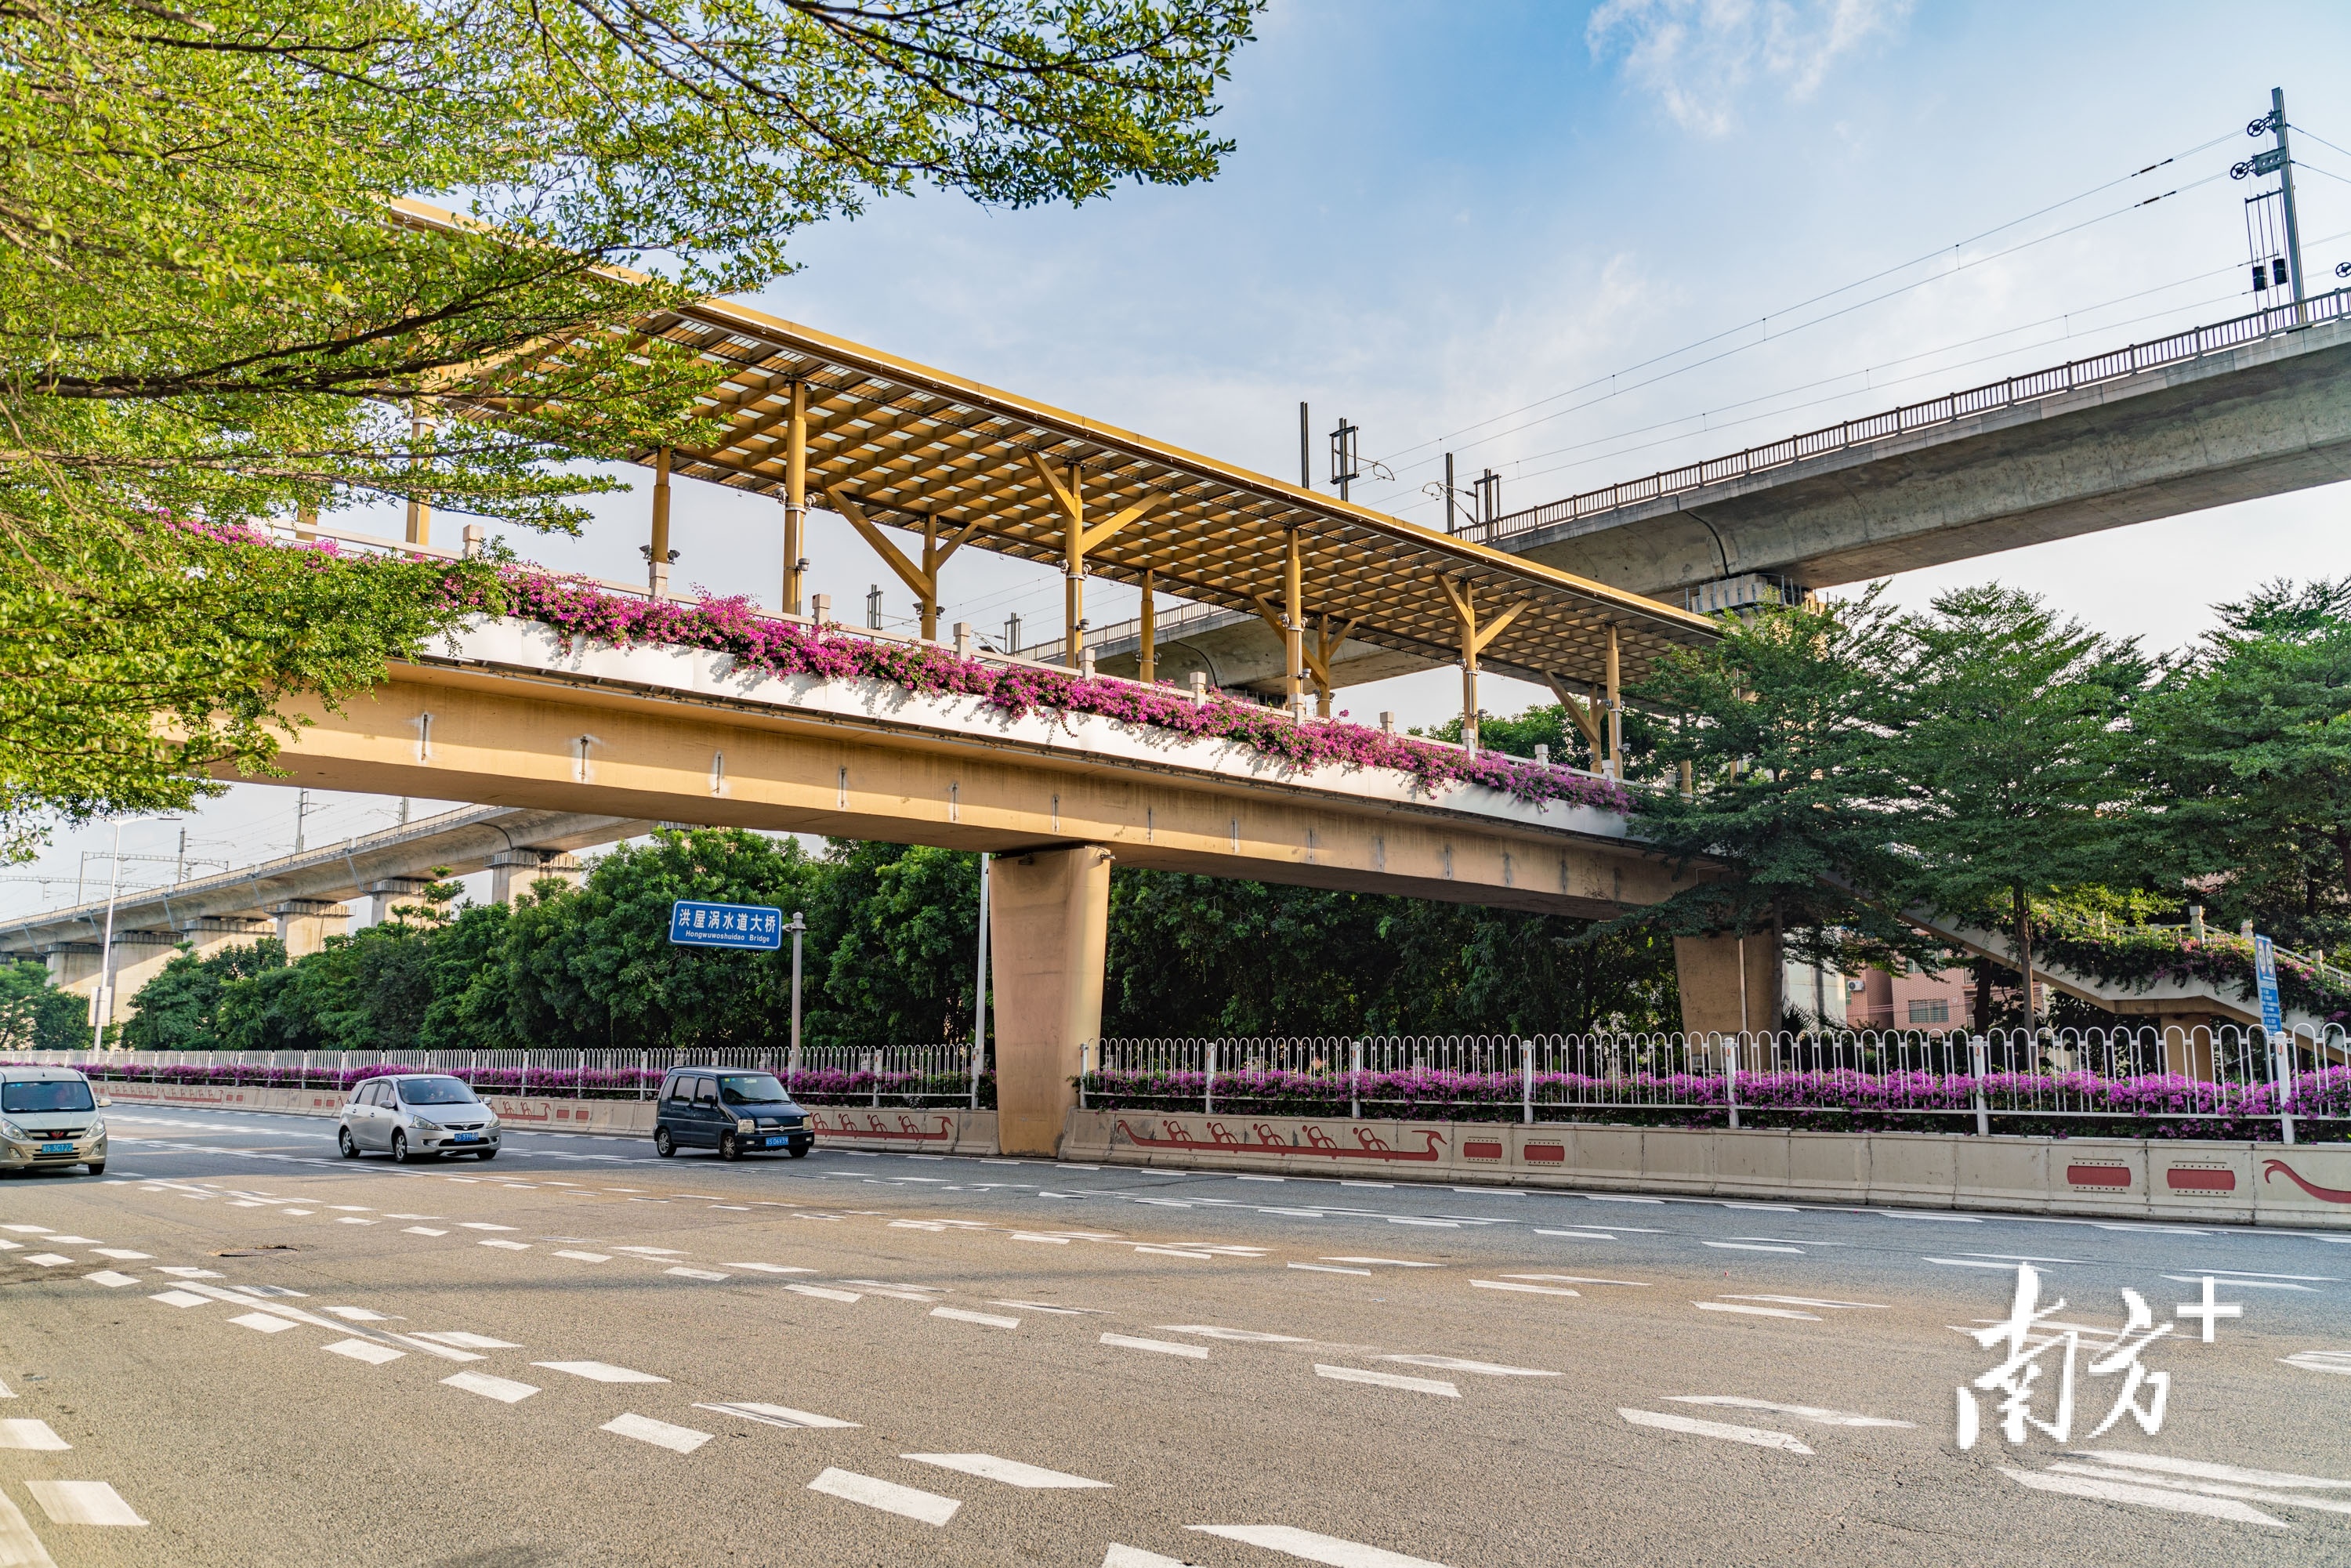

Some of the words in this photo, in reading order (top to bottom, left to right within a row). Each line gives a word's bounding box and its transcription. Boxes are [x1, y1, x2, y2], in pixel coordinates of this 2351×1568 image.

[679, 908, 776, 932] 洪屋涡水道大桥
[686, 930, 744, 940] Hongwuwoshuidao
[749, 934, 770, 943] Bridge
